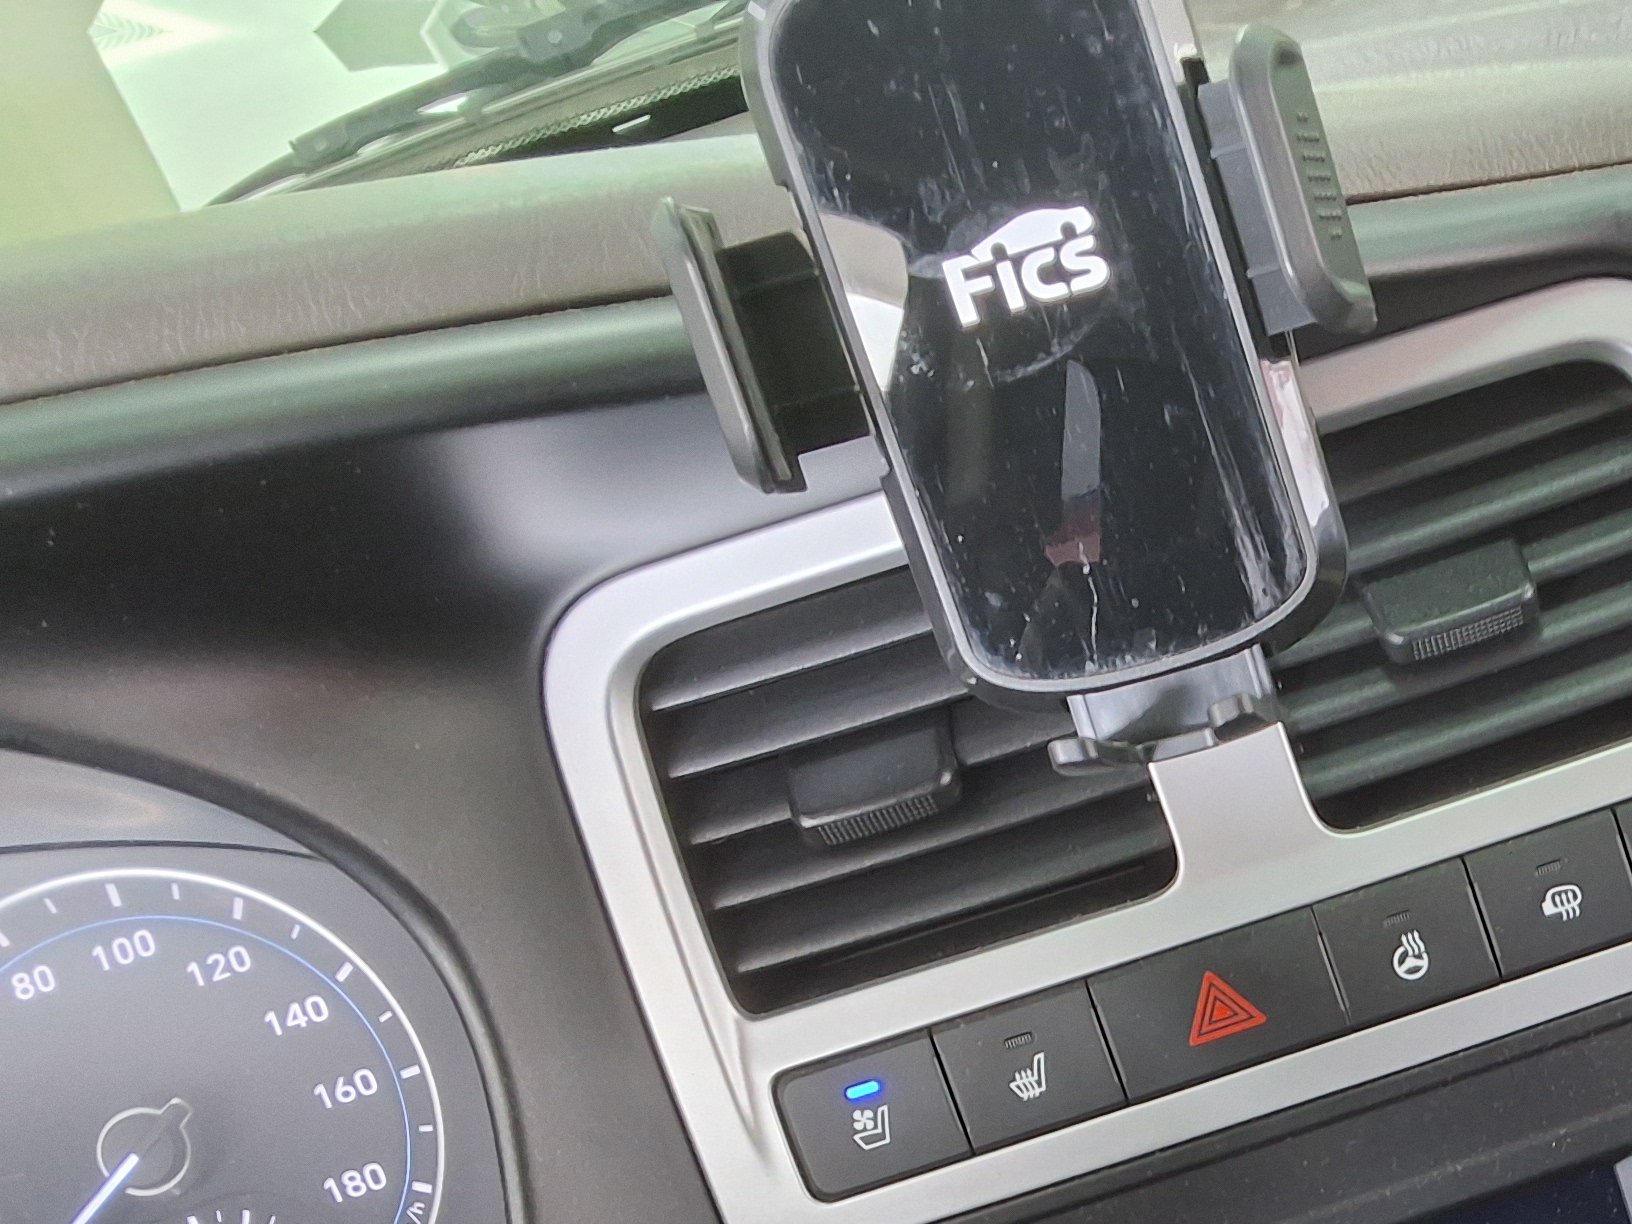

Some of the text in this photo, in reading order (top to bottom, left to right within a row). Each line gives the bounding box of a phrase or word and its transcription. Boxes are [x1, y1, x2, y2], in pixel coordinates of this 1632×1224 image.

[91, 929, 156, 972] 100
[186, 945, 252, 986] 120
[11, 965, 56, 1000] 80
[264, 994, 329, 1036] 140
[313, 1068, 378, 1109] 160
[323, 1162, 387, 1203] 180
